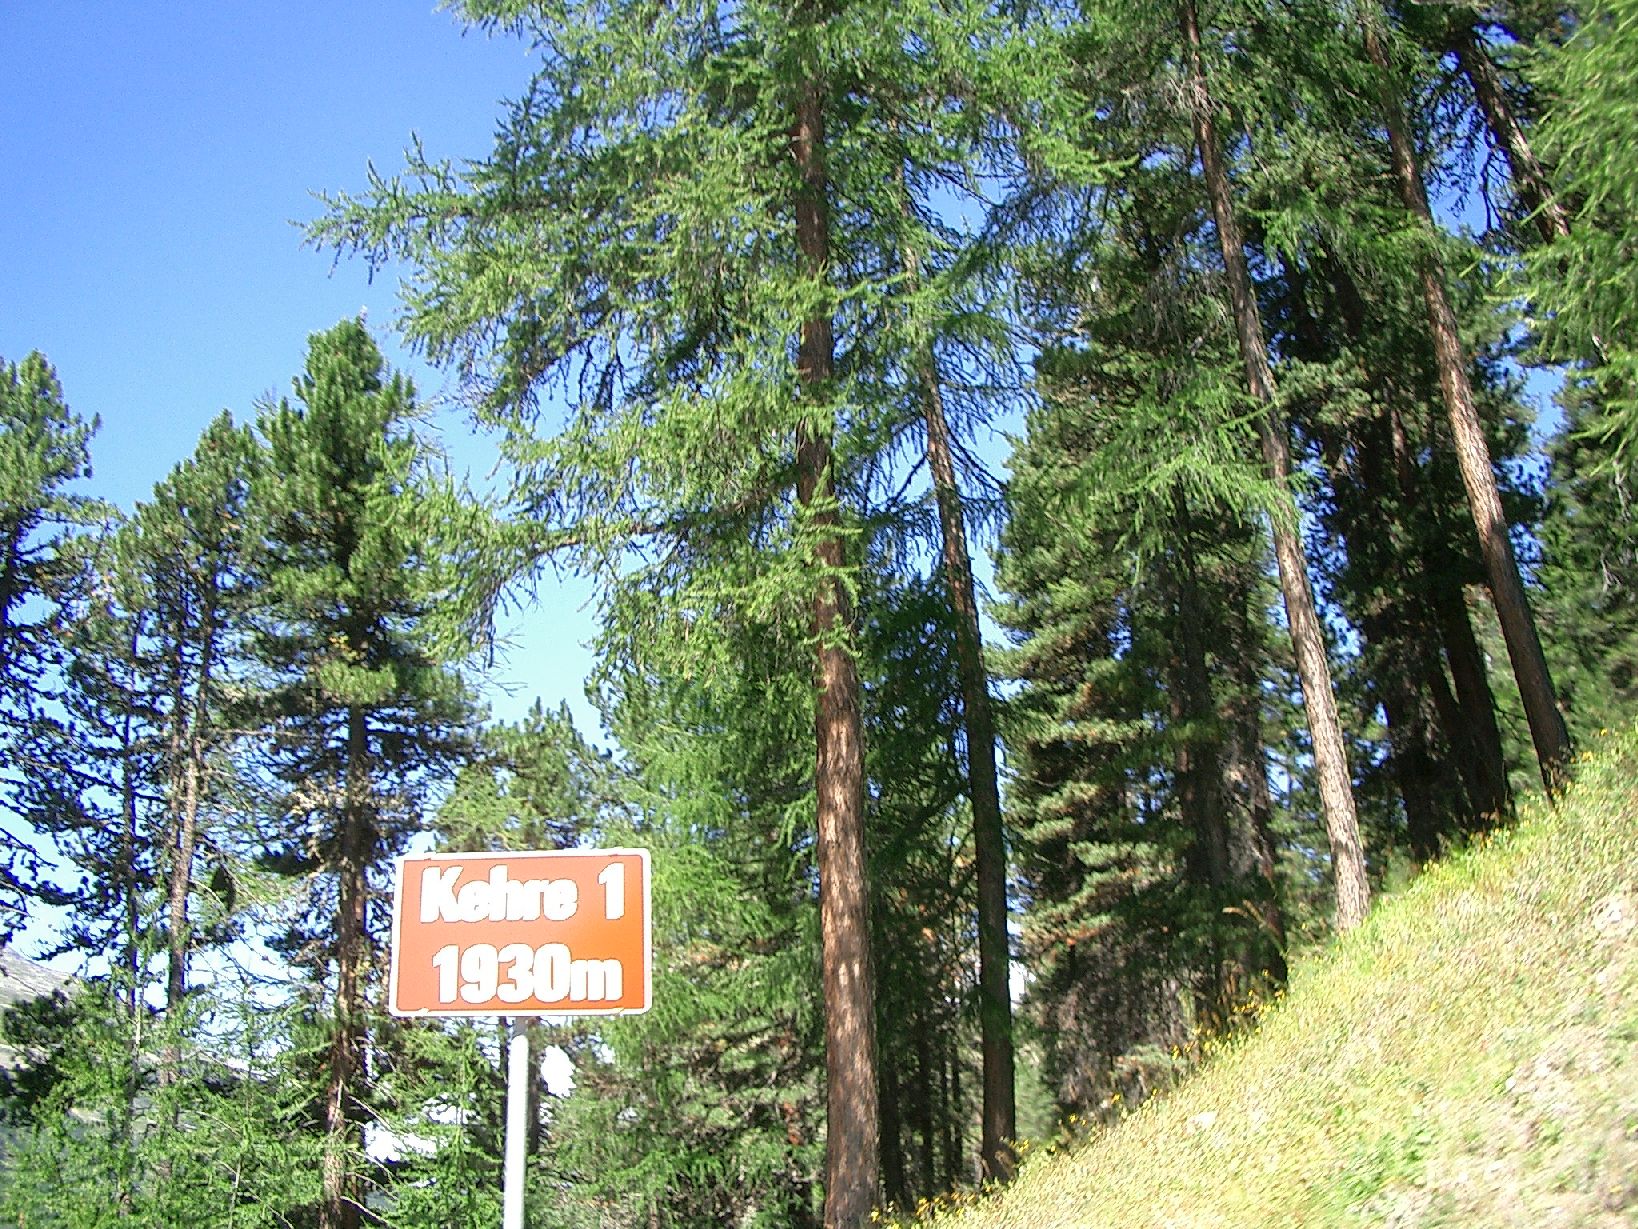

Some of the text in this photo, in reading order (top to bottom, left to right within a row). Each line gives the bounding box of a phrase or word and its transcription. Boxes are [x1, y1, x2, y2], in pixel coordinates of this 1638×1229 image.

[419, 862, 625, 924] Kehre 1
[432, 943, 623, 1004] 1930m
